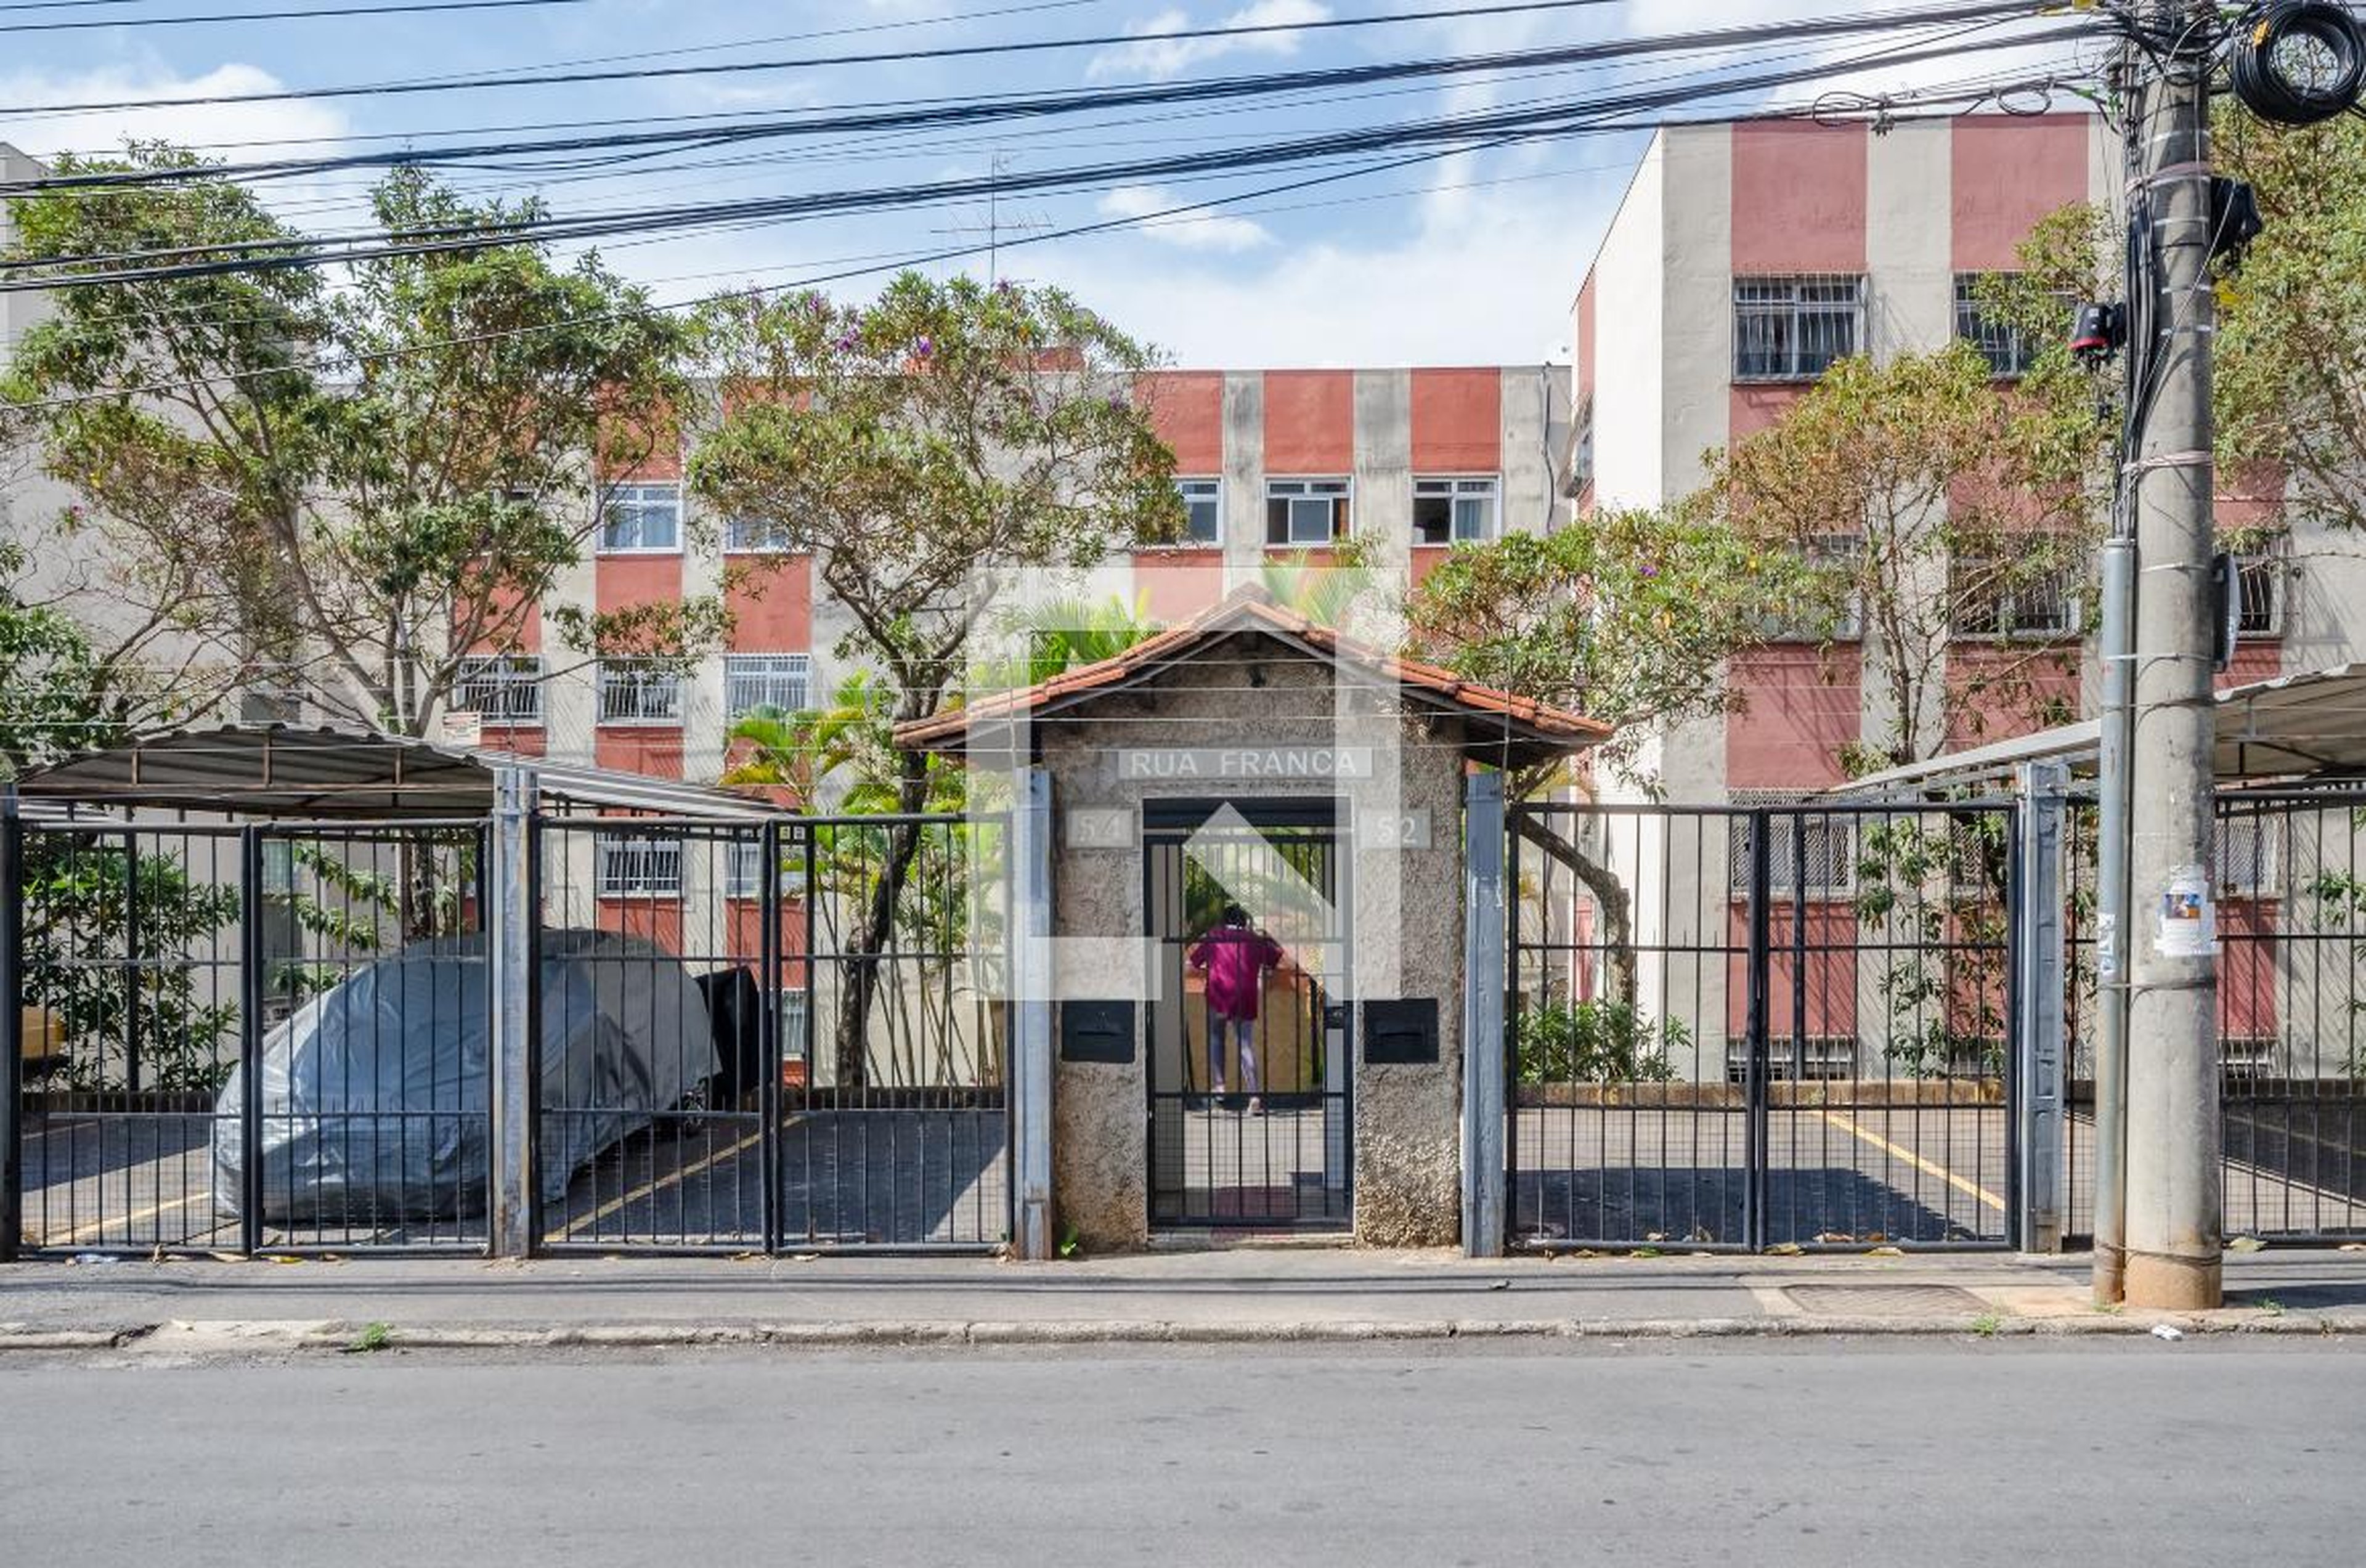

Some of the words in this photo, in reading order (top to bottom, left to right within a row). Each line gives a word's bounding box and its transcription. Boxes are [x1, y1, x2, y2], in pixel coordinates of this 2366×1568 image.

[1131, 750, 1198, 776] RUA
[1220, 750, 1357, 776] FRANCA
[1376, 816, 1417, 844] 52
